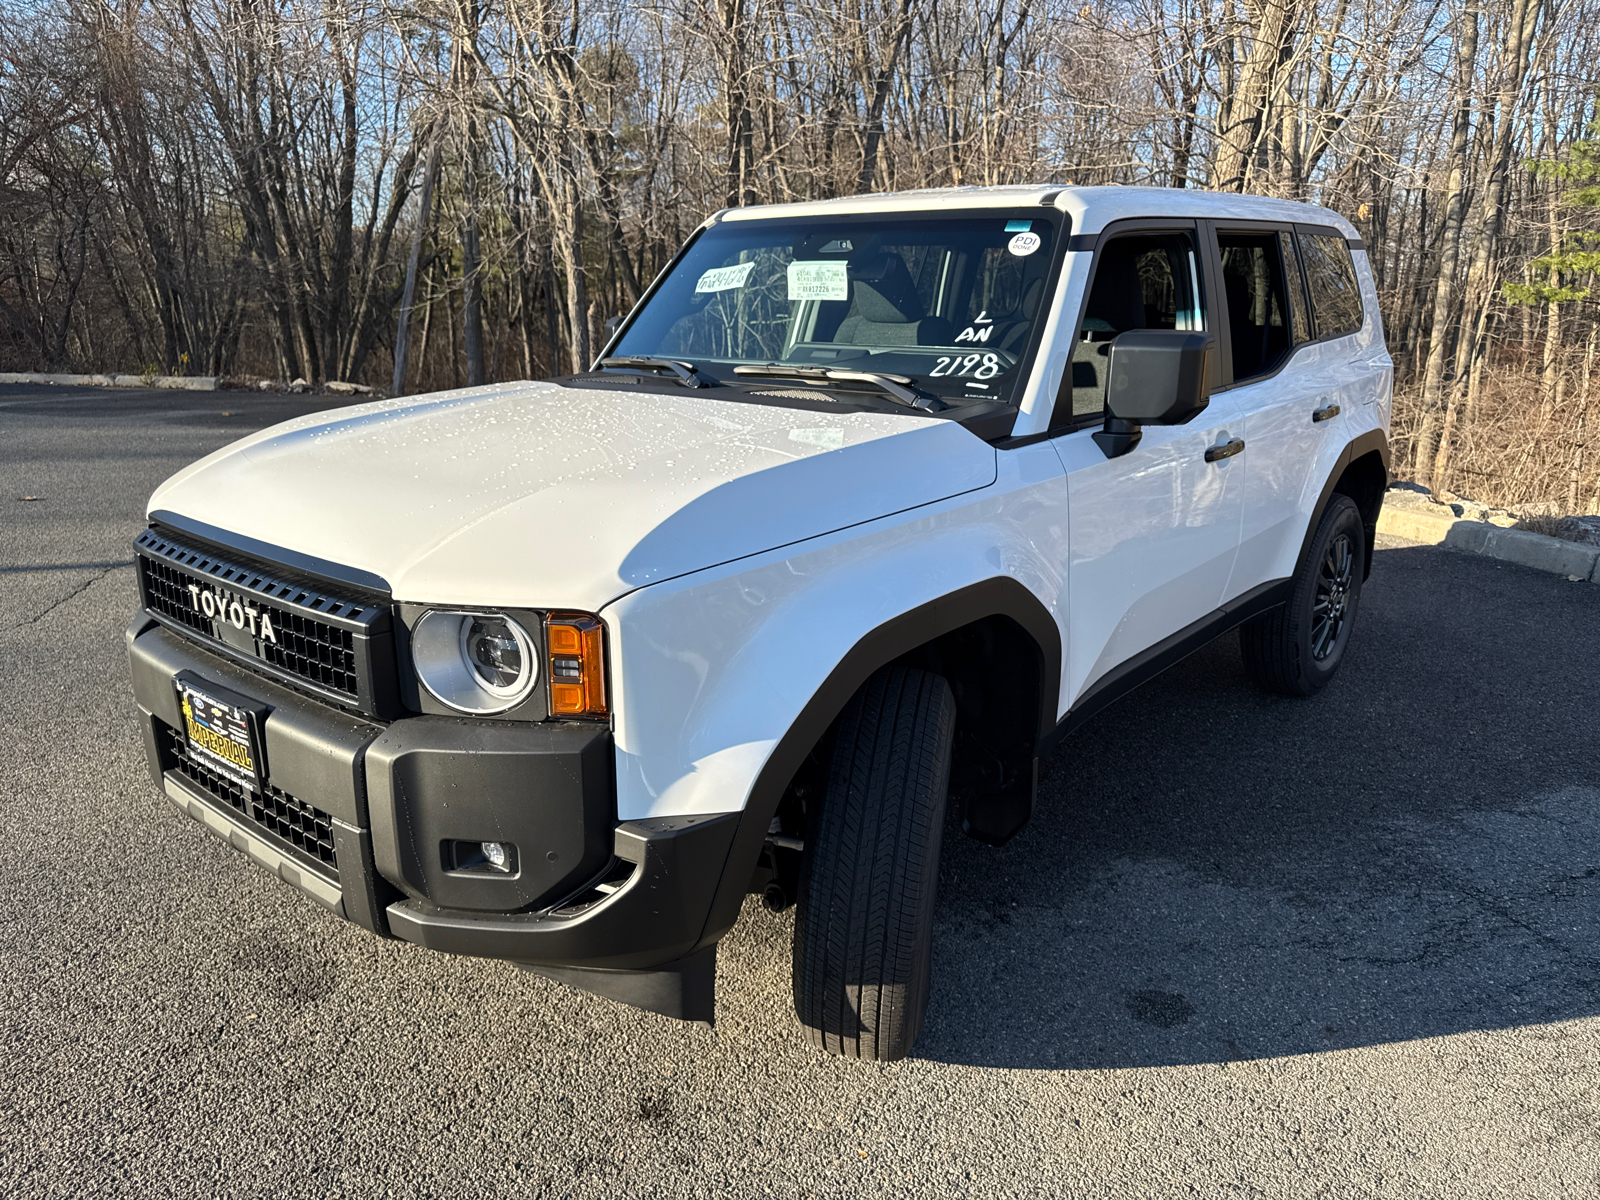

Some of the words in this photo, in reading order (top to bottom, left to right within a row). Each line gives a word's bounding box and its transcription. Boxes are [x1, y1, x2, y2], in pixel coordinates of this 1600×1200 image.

[1015, 236, 1037, 246] PDI
[973, 310, 993, 324] L
[954, 325, 994, 343] AN
[929, 353, 999, 379] 2198
[188, 584, 277, 643] TOYOTA
[187, 718, 254, 771] IMPERIAL
